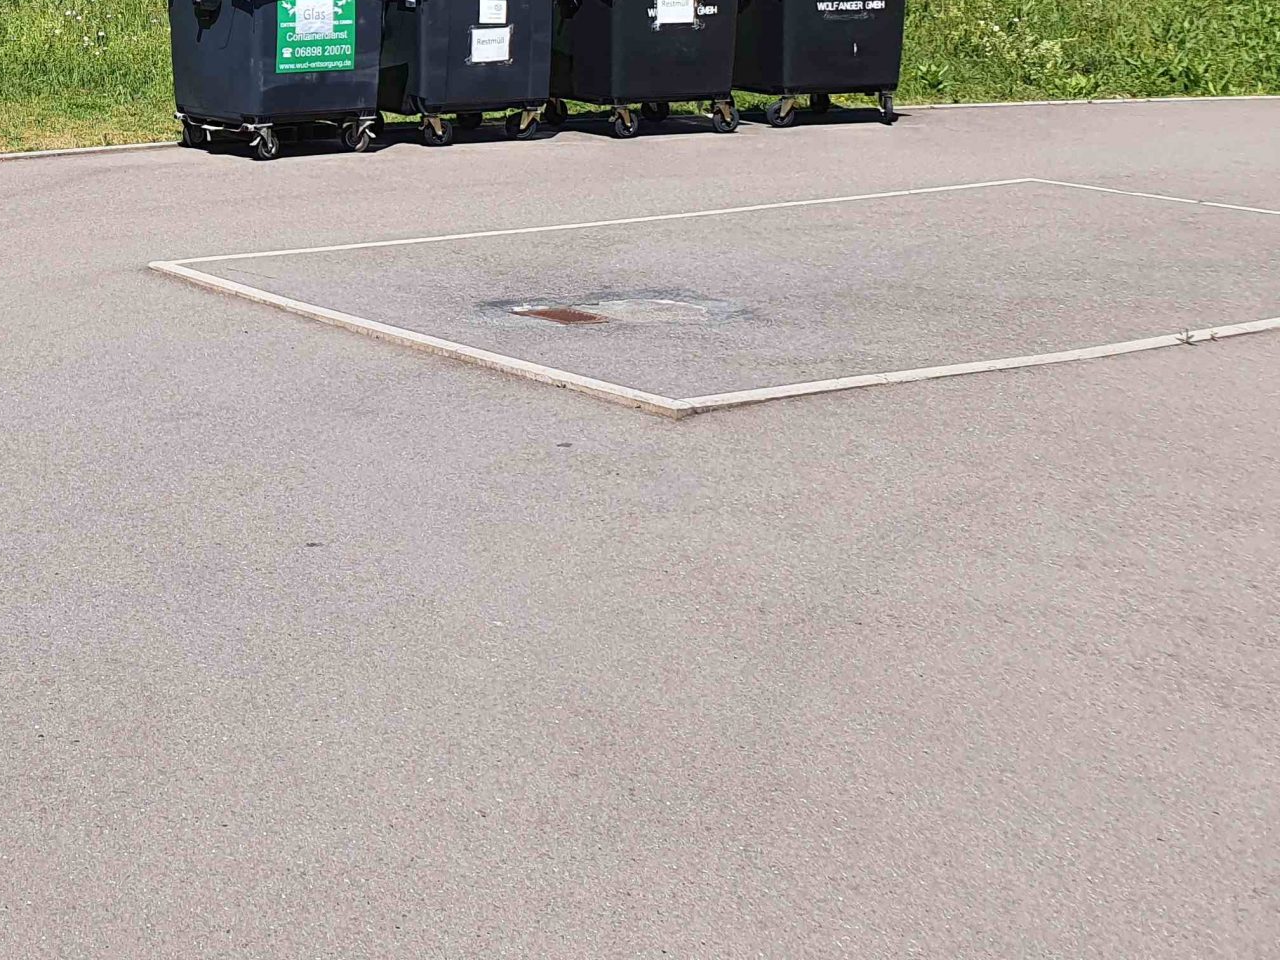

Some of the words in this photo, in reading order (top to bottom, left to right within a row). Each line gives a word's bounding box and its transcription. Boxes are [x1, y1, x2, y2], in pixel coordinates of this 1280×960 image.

[697, 5, 718, 15] GMBH
[816, 1, 863, 11] WOLFANGER
[865, 0, 886, 10] GMBH
[303, 7, 326, 20] Glas
[287, 31, 348, 41] Containerdienst
[477, 37, 505, 45] Restmüll
[295, 46, 322, 57] 06898
[324, 45, 351, 55] 20070
